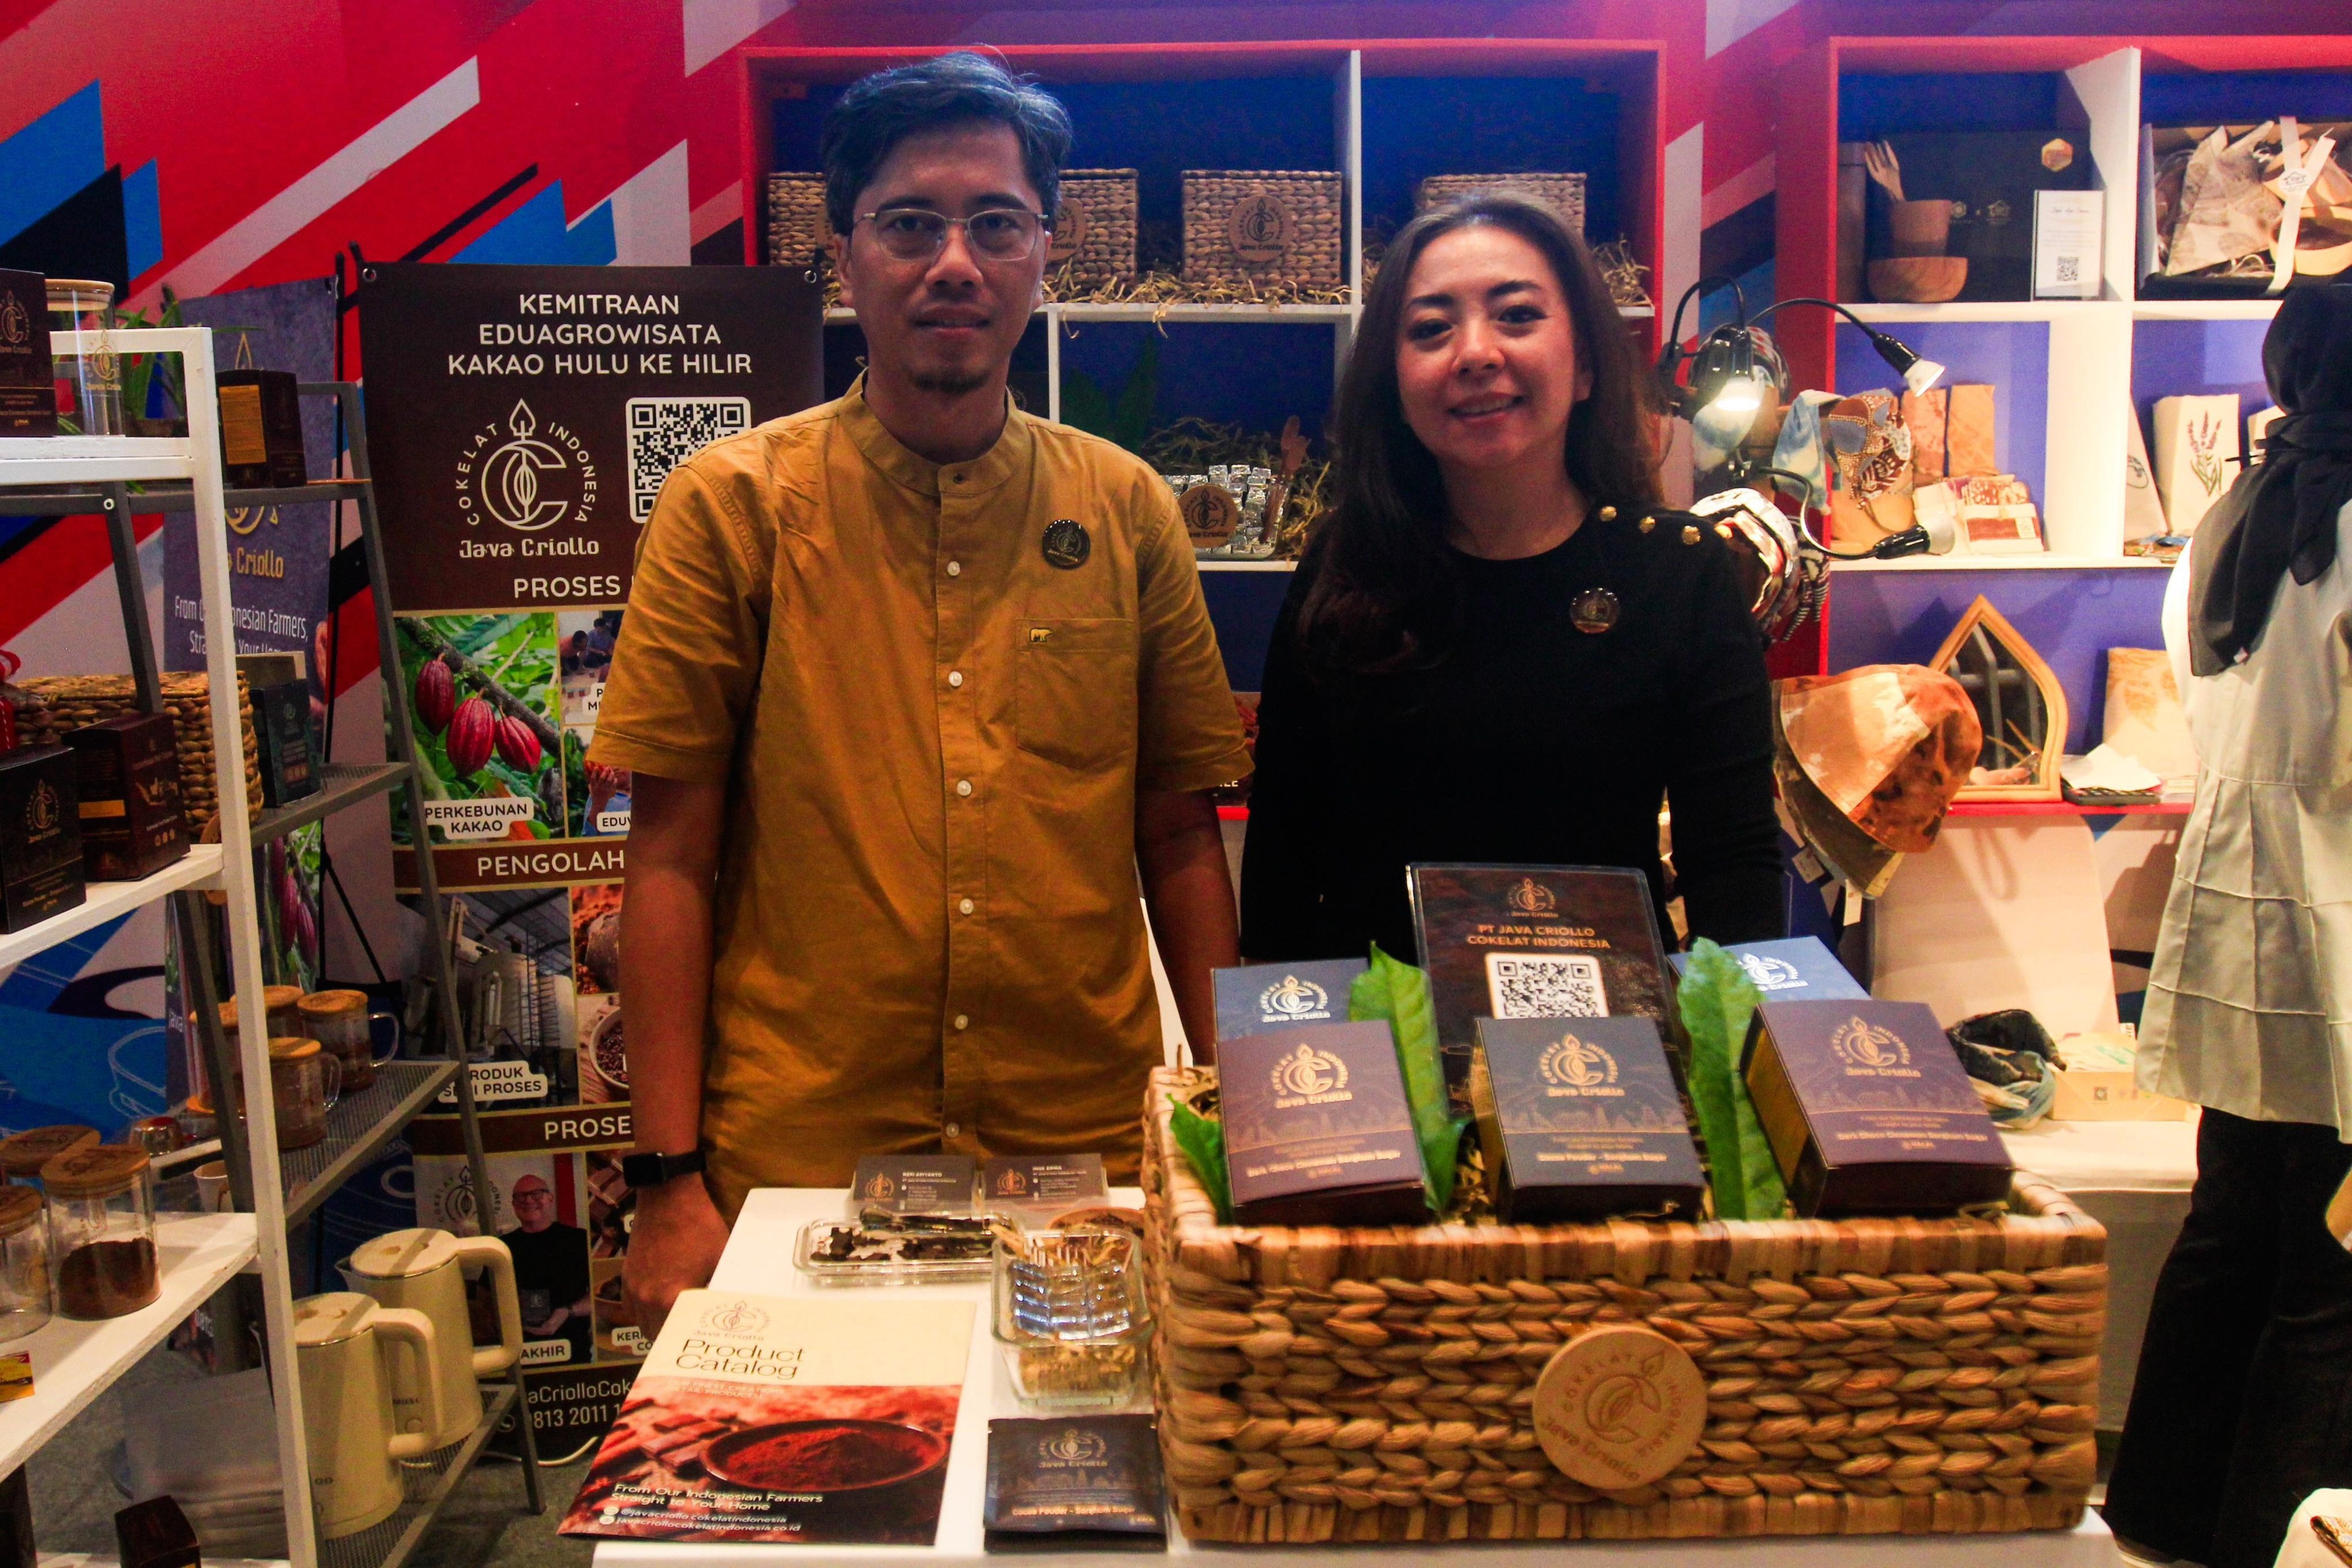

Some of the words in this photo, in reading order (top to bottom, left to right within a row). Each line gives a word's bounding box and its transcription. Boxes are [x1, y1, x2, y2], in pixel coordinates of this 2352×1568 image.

[520, 293, 679, 315] KEMITRAAN
[479, 324, 721, 345] EDUAGROWISATA
[448, 354, 544, 376] KAKAO
[555, 354, 629, 374] HULU
[641, 354, 671, 374] KE
[684, 353, 752, 373] HILIR
[456, 423, 498, 527] COKELAT
[549, 422, 597, 523] INDONESIA
[460, 540, 514, 559] Java
[522, 538, 599, 557] Criollo
[236, 547, 284, 578] Criollo
[514, 576, 621, 599] PROSES
[175, 595, 196, 620] From
[268, 609, 308, 643] Farmers,
[189, 630, 206, 655] Stra
[425, 803, 528, 819] PERKEBUNAN
[450, 820, 503, 833] KAKAO
[478, 850, 625, 877] PENGOLAH
[1466, 935, 1529, 946] COKELAT
[1533, 937, 1611, 950] INDONESIA
[1477, 924, 1494, 934] PT
[1498, 925, 1532, 936] JAVA
[1535, 926, 1595, 938] CRIOLLO
[469, 1066, 523, 1081] RODUK
[483, 1080, 541, 1096] PROSES
[544, 1116, 632, 1141] PROSE
[521, 1345, 566, 1359] AKHIR
[682, 1338, 806, 1362] Product
[675, 1354, 799, 1380] Catalog
[528, 1379, 632, 1404] aCriolloCok
[532, 1409, 564, 1429] 813
[570, 1405, 608, 1425] 2011
[610, 1493, 666, 1506] Straight
[670, 1497, 684, 1506] to
[692, 1499, 723, 1509] Your
[728, 1502, 770, 1511] Home
[614, 1484, 651, 1495] From
[655, 1487, 682, 1497] Our
[686, 1490, 762, 1502] Indonesian
[766, 1494, 823, 1503] Farmers
